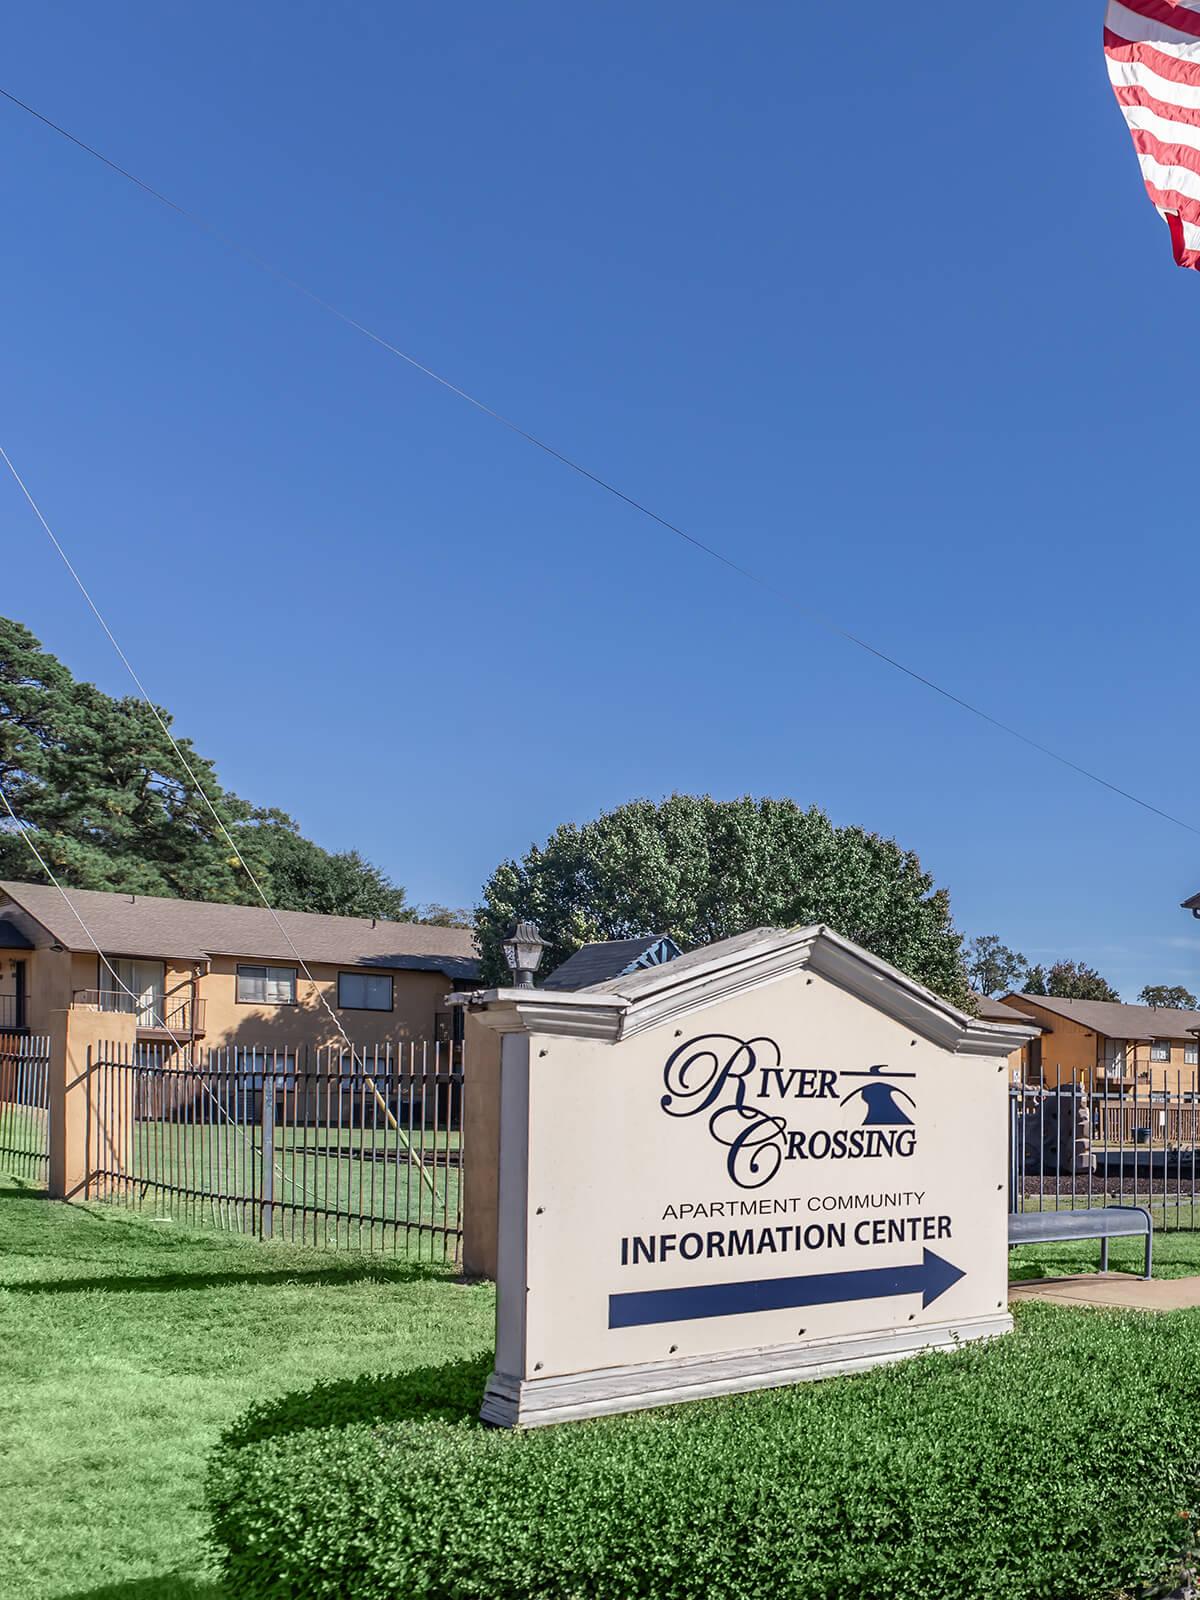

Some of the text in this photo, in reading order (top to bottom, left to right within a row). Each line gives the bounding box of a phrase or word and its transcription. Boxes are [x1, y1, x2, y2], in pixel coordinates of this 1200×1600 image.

[660, 1033, 840, 1120] RIVER
[708, 1104, 918, 1190] CROSSING
[661, 1191, 926, 1221] APARTMENT COMMUNITY
[620, 1215, 953, 1266] INFORMATION CENTER
